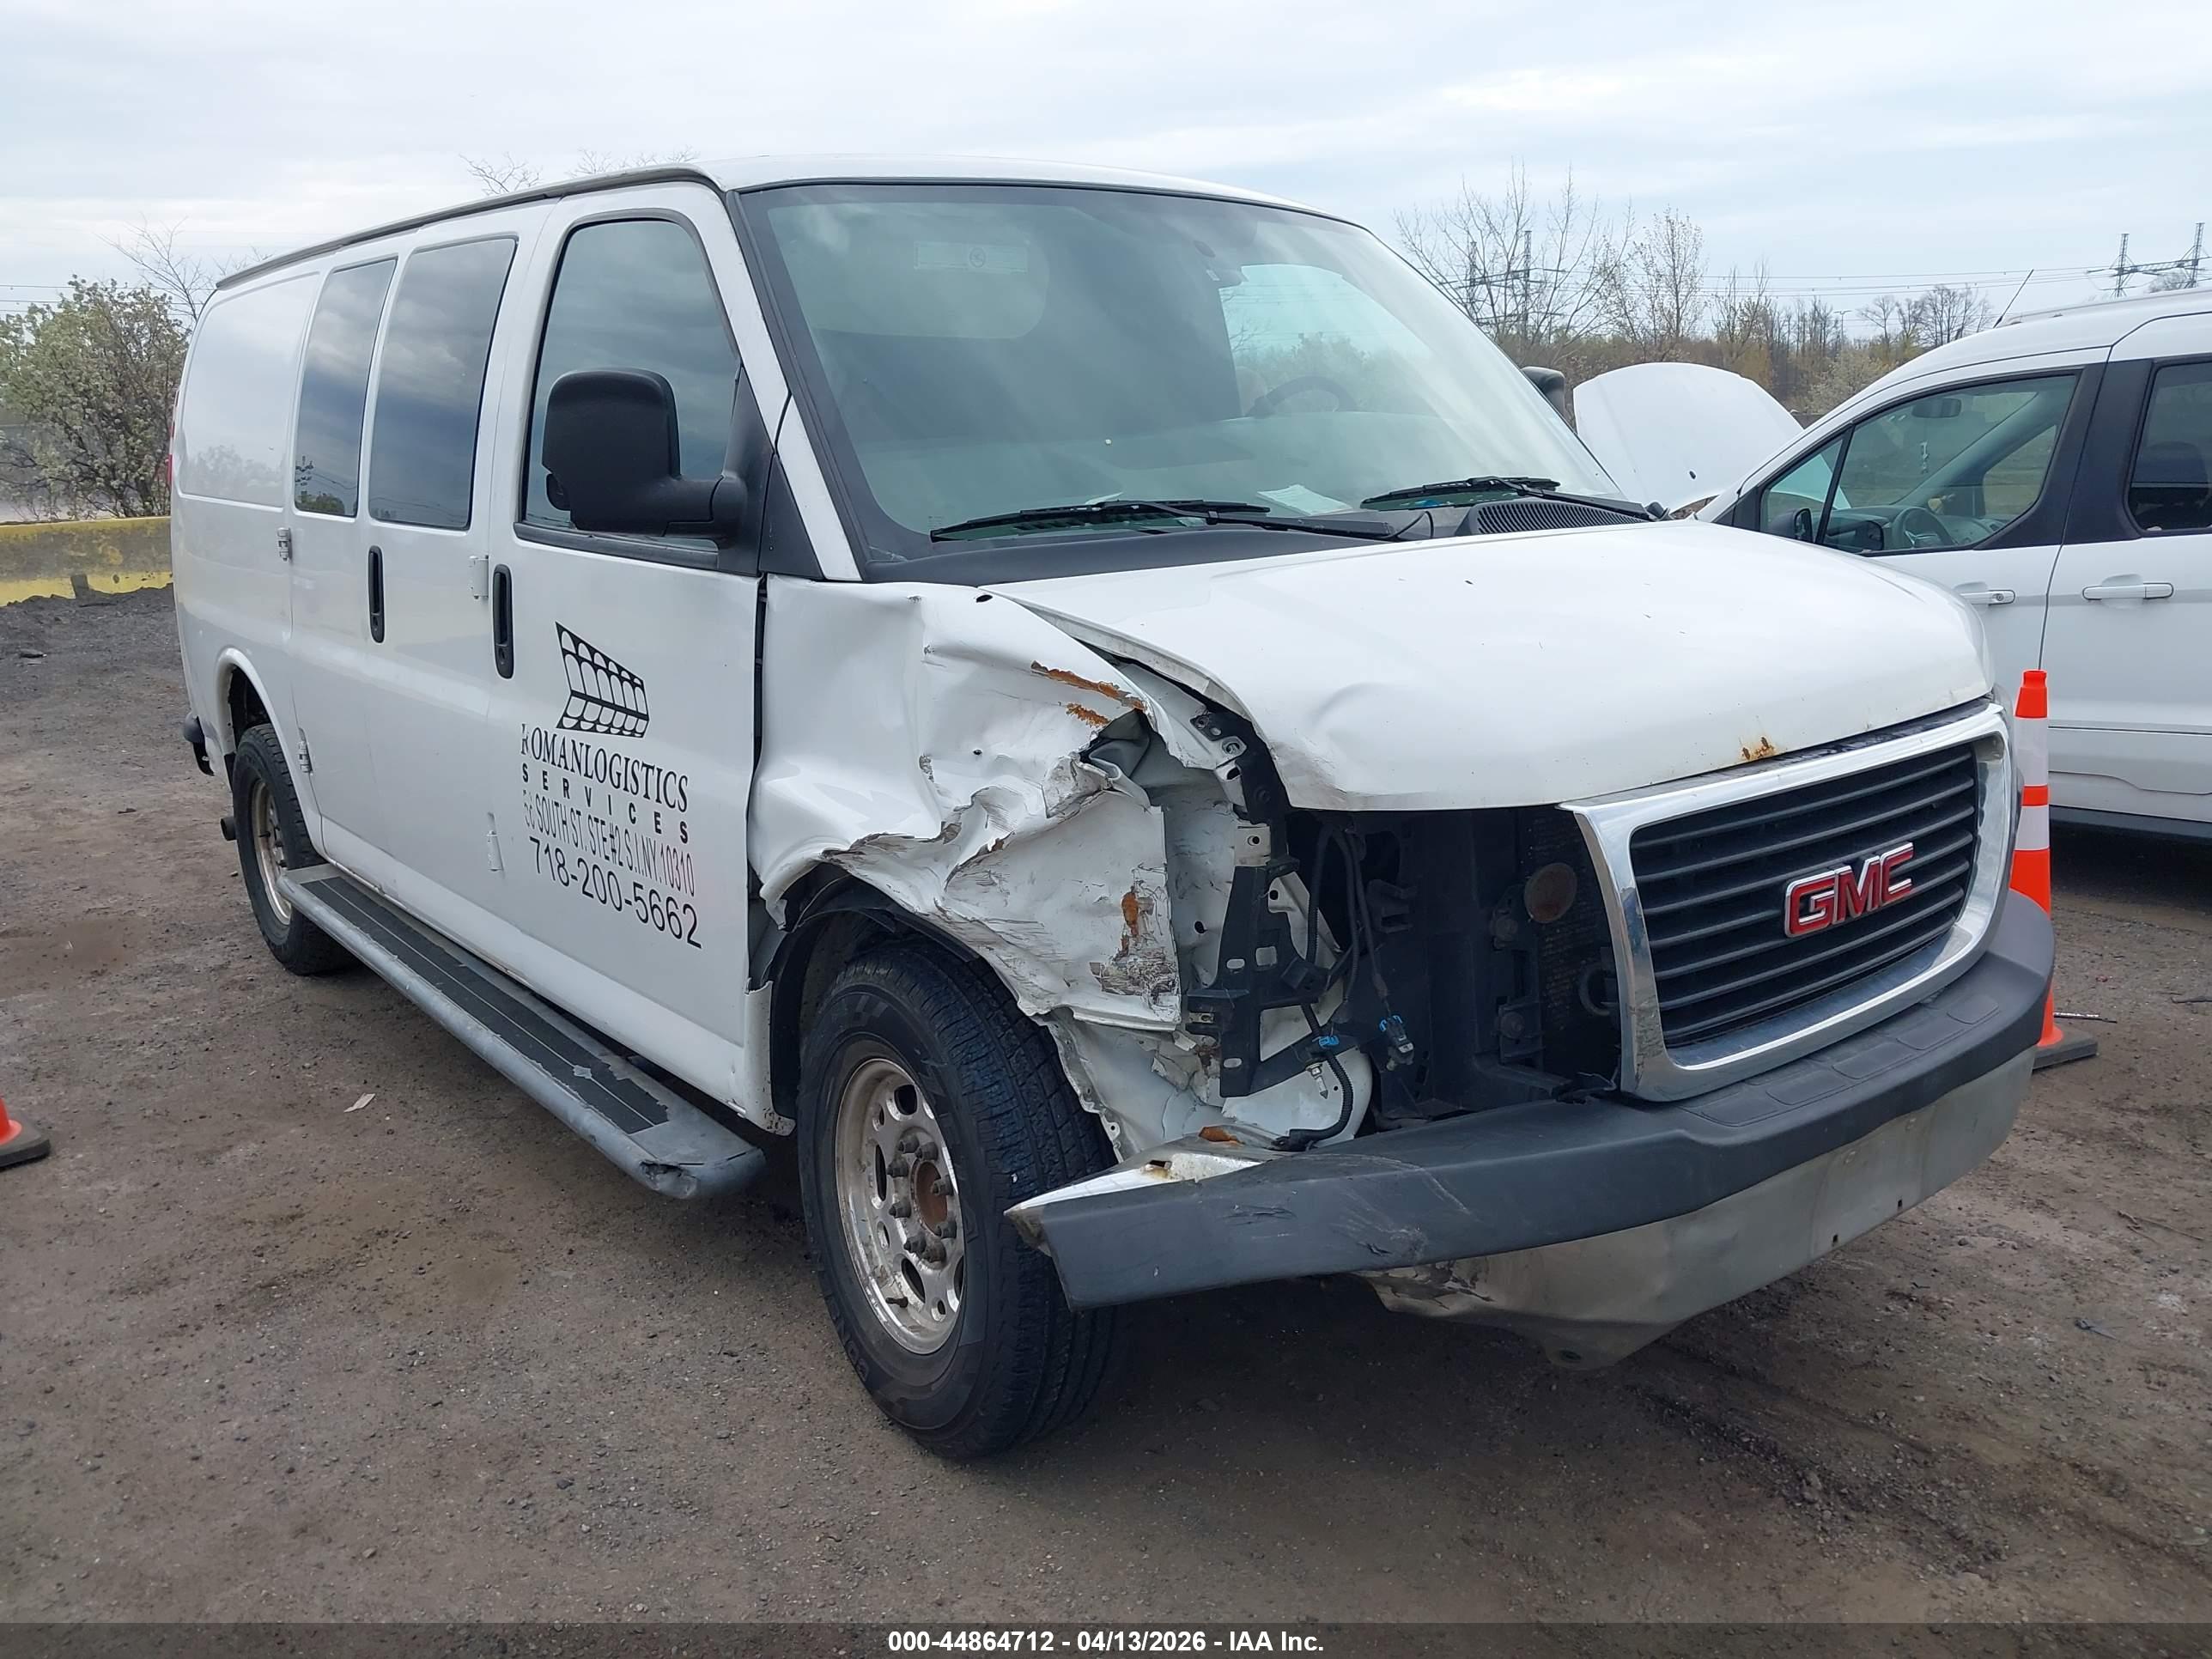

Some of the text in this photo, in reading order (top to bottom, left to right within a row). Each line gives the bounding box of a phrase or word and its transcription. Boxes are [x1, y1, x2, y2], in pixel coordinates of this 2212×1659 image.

[522, 763, 690, 844] SERVICES
[535, 793, 570, 845] SOUTH
[530, 836, 703, 950] 718-200-5662
[1784, 842, 1914, 939] GMC
